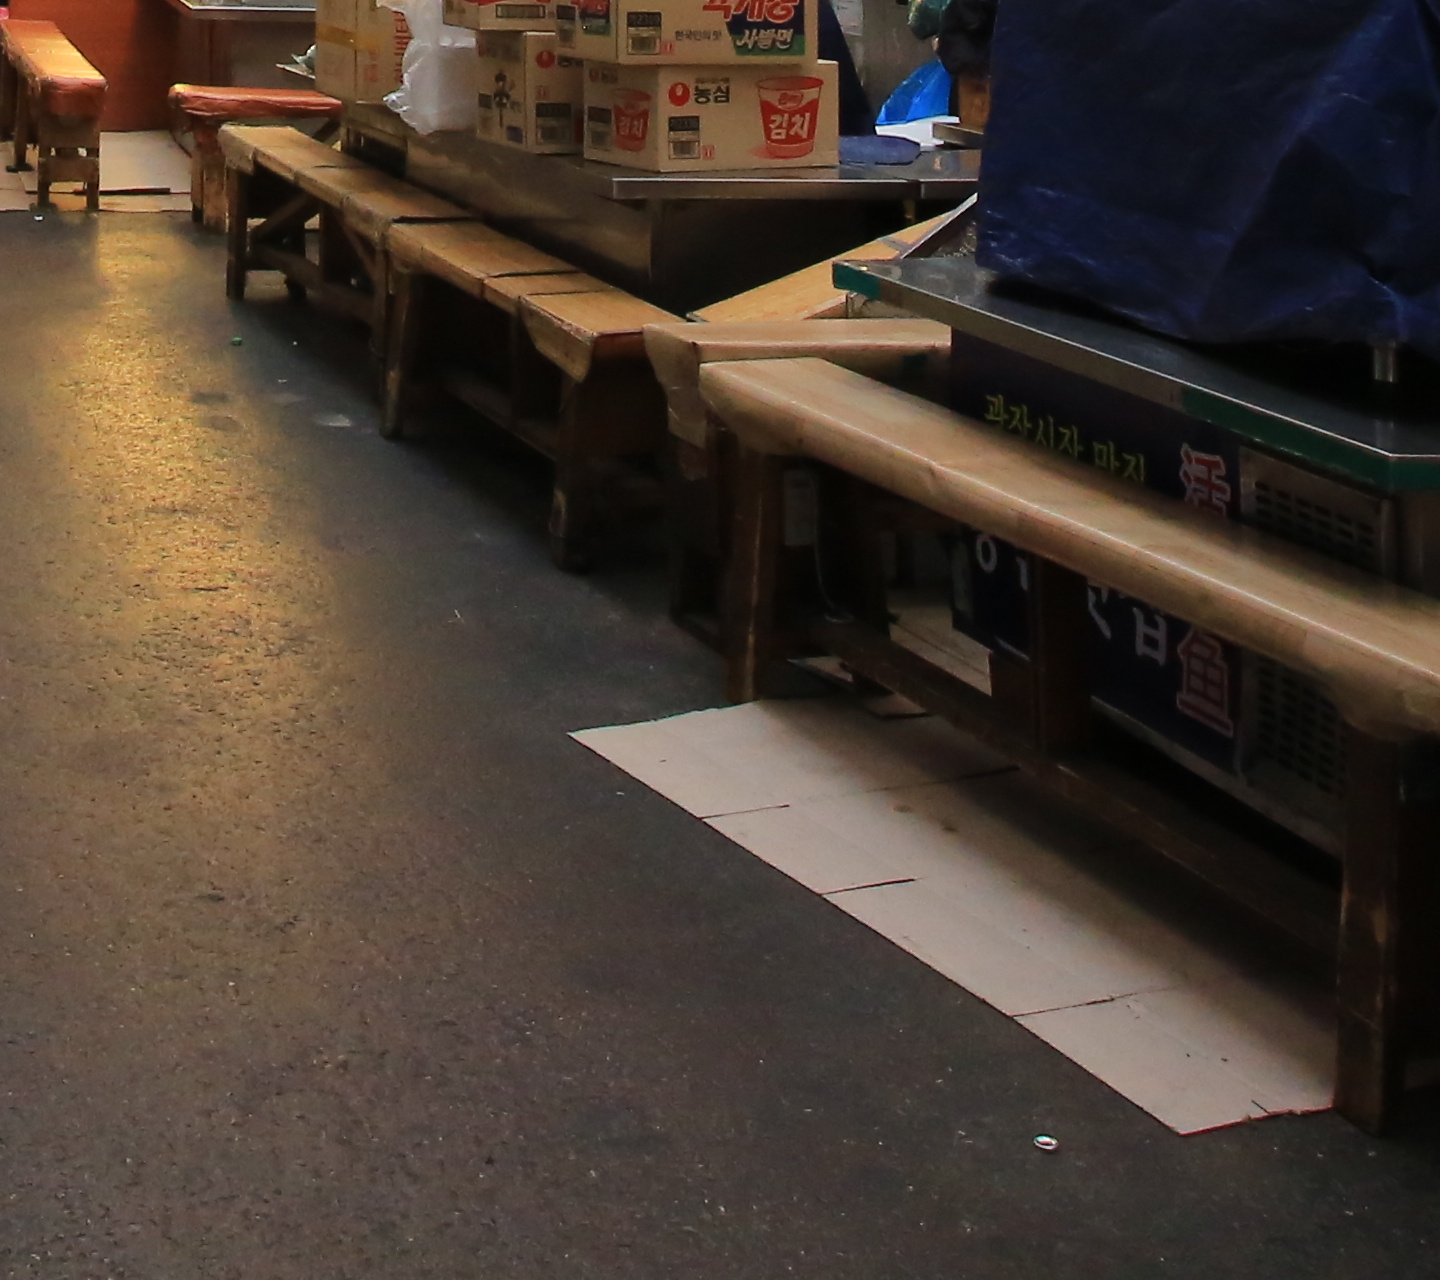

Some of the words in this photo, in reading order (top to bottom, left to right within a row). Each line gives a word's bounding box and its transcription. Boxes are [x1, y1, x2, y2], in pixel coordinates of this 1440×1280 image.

[732, 27, 795, 51] 사발면
[694, 85, 730, 104] 농심
[769, 112, 812, 140] 김치
